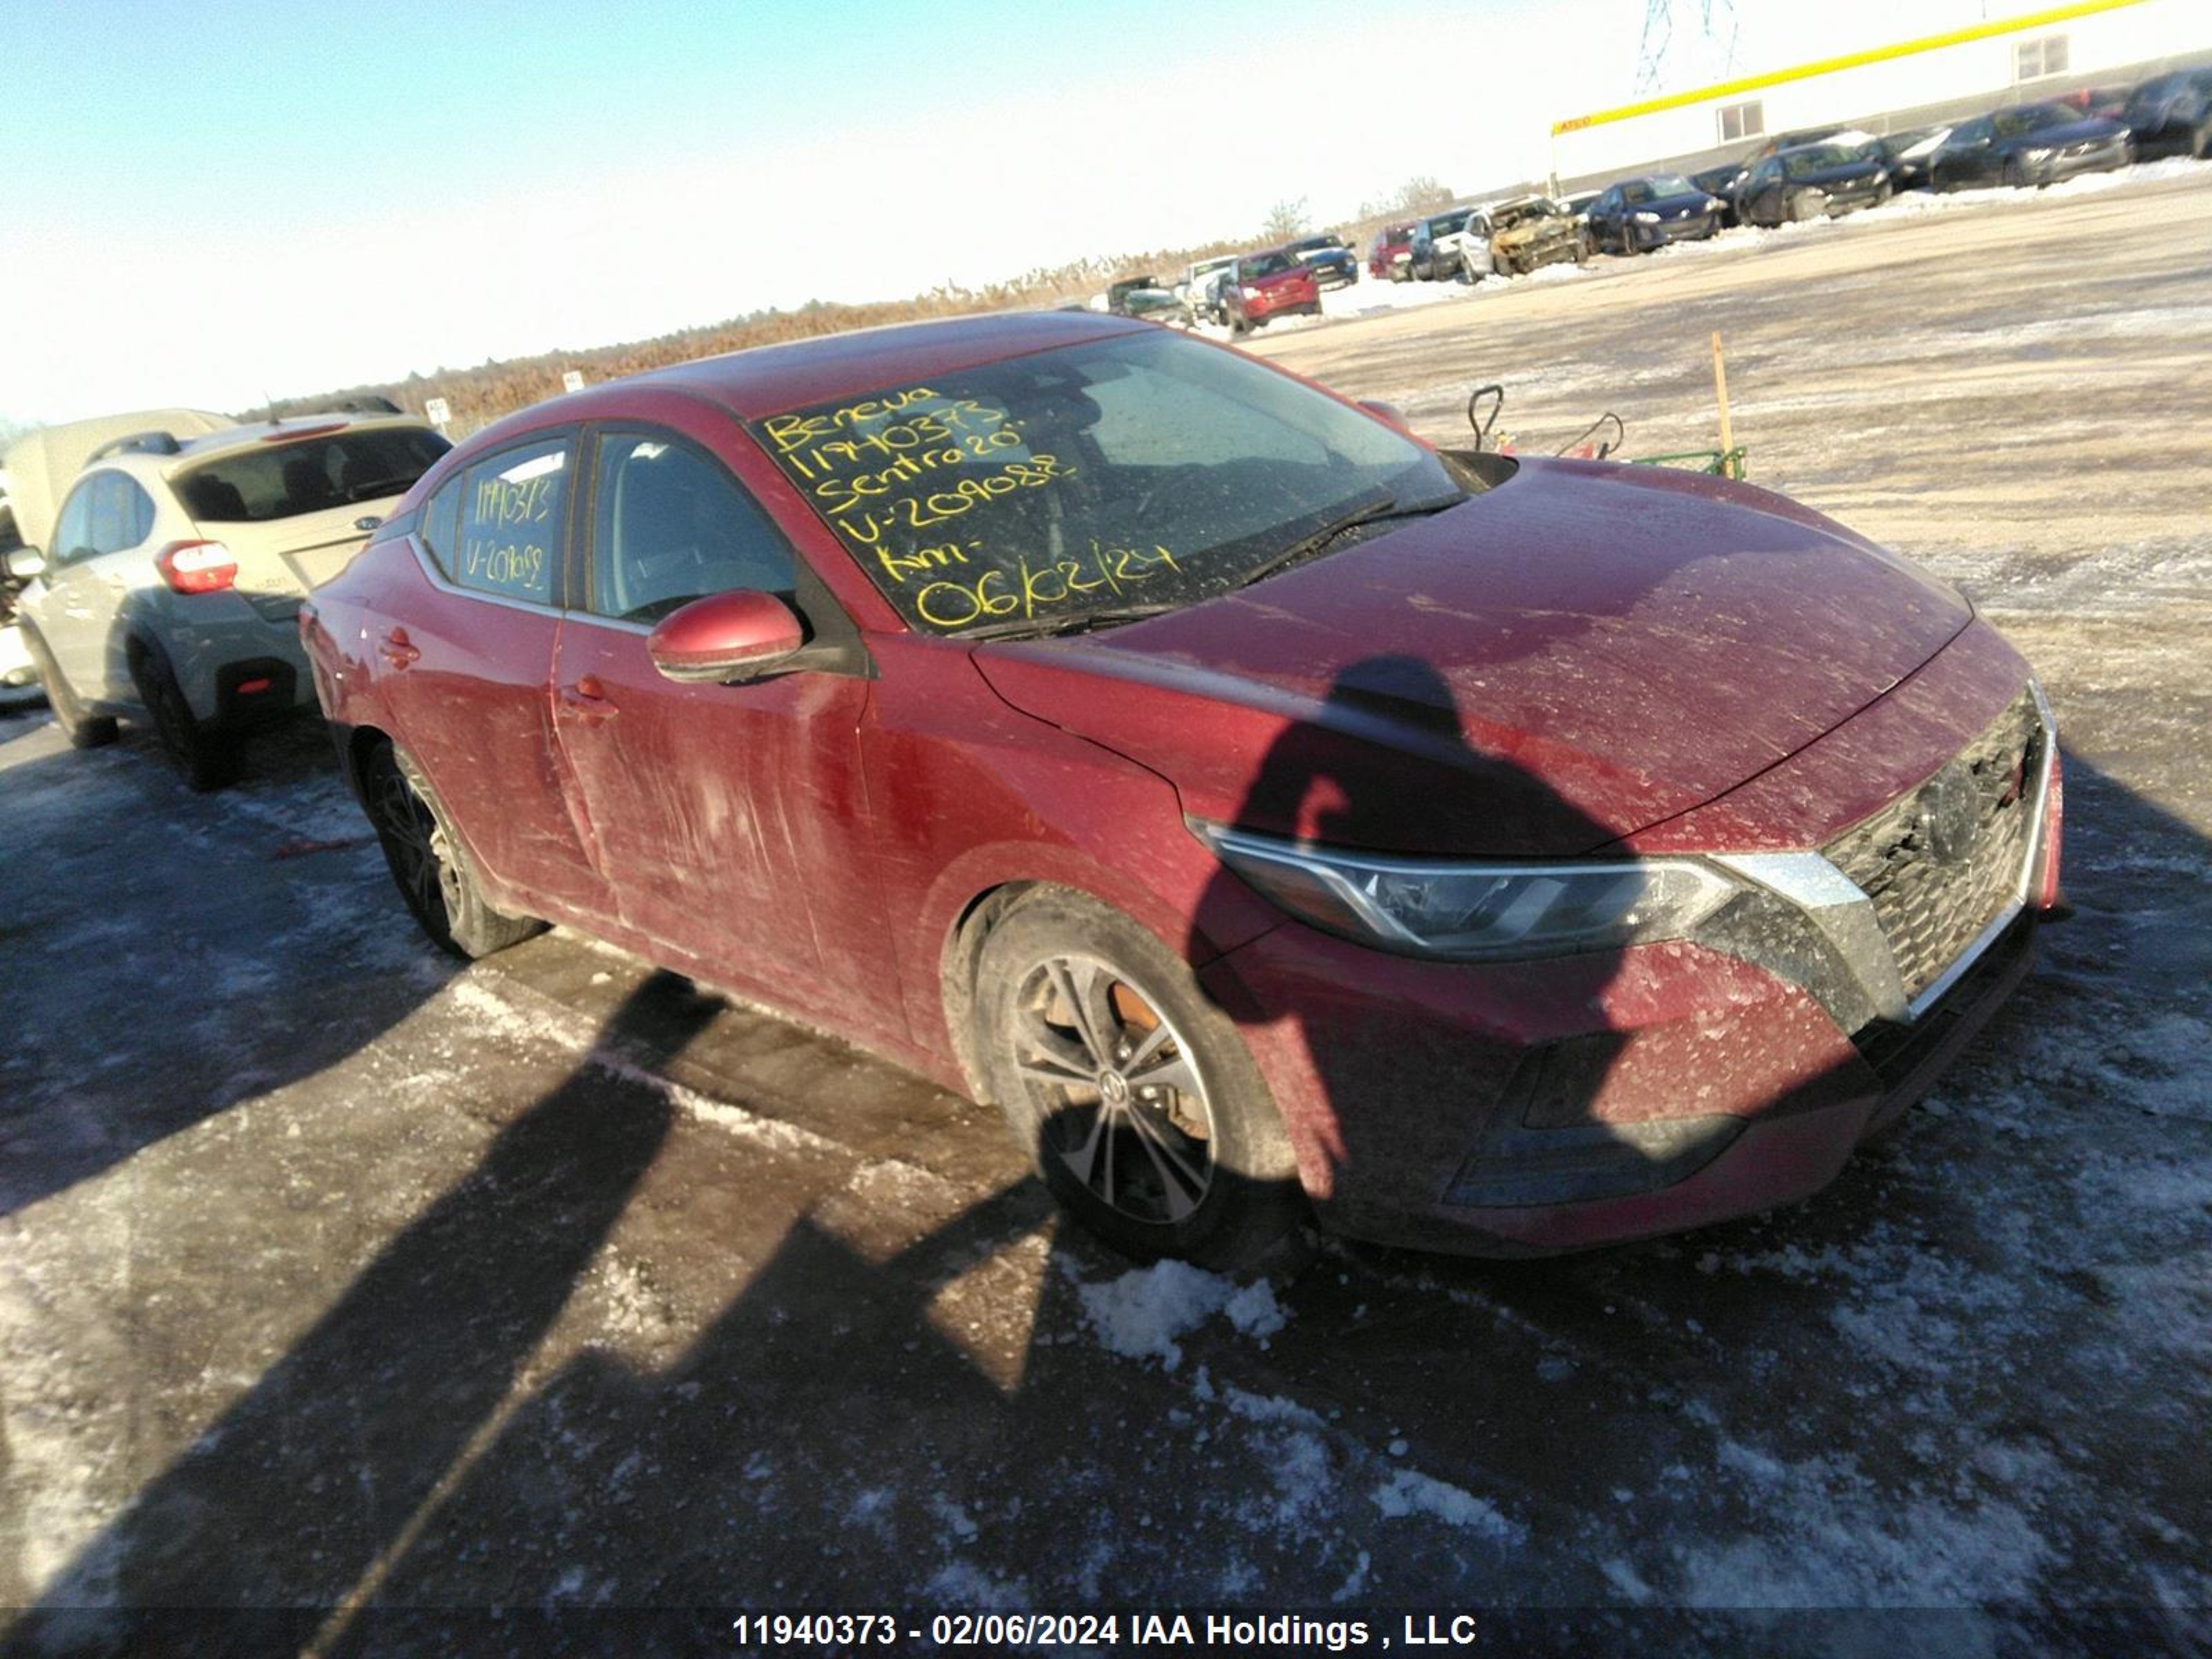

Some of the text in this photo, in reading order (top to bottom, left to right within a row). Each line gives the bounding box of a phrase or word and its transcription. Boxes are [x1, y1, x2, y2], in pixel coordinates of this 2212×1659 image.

[789, 400, 1003, 479] 11940373
[816, 449, 966, 514] Sentra
[917, 538, 1181, 626] 06/02/24
